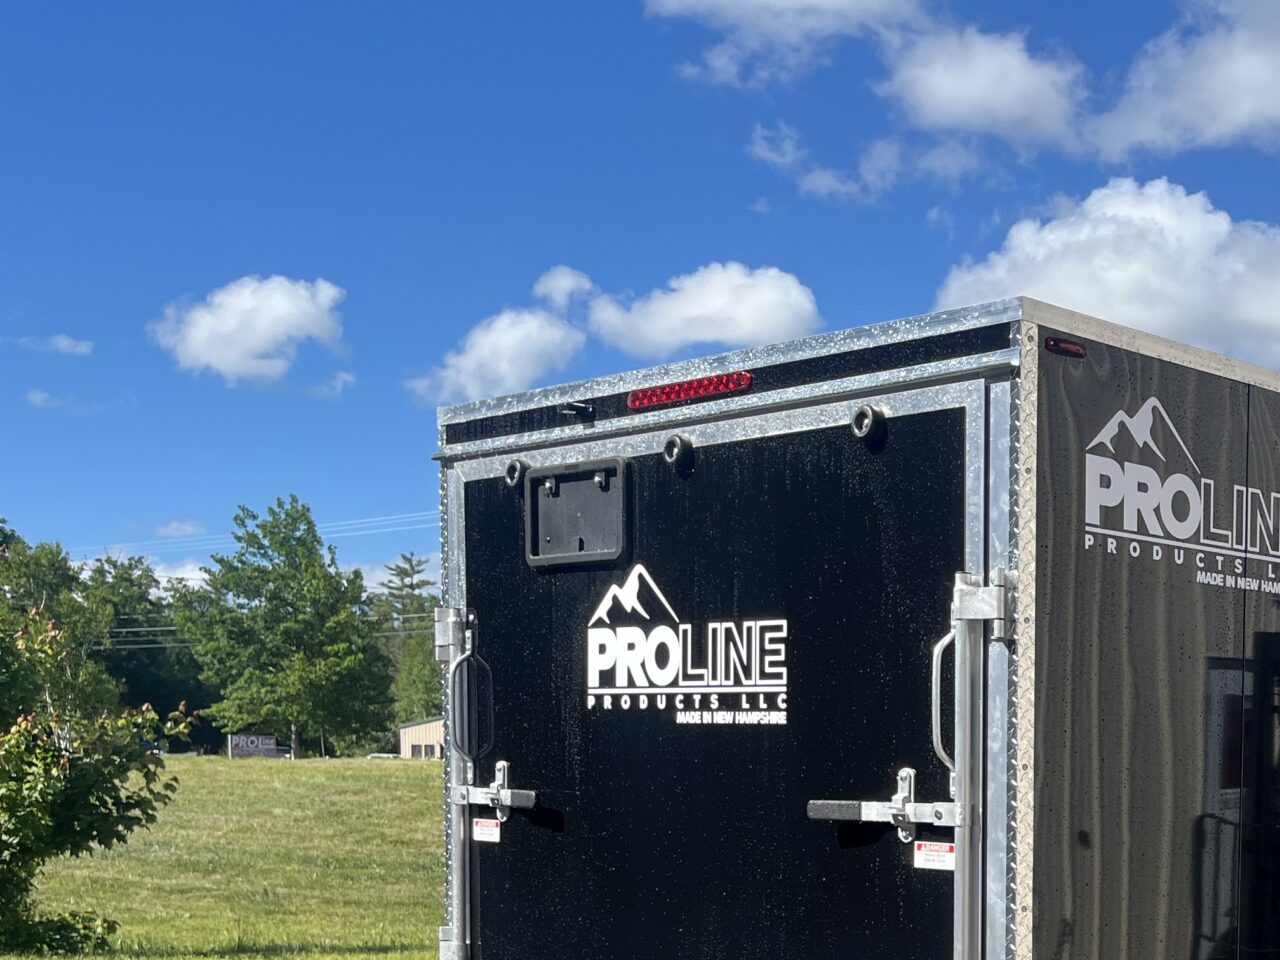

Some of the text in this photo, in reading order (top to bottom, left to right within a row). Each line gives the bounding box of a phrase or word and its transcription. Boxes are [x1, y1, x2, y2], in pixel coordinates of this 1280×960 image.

[1084, 533, 1243, 574] PRODUCTS
[1196, 571, 1224, 586] MADE
[1226, 574, 1235, 588] IN
[1237, 576, 1260, 591] NEW
[587, 619, 788, 688] PROLINE
[587, 693, 788, 710] PRODUCTS LLC
[676, 711, 788, 725] MADE IN NEW HAMPSHIRE
